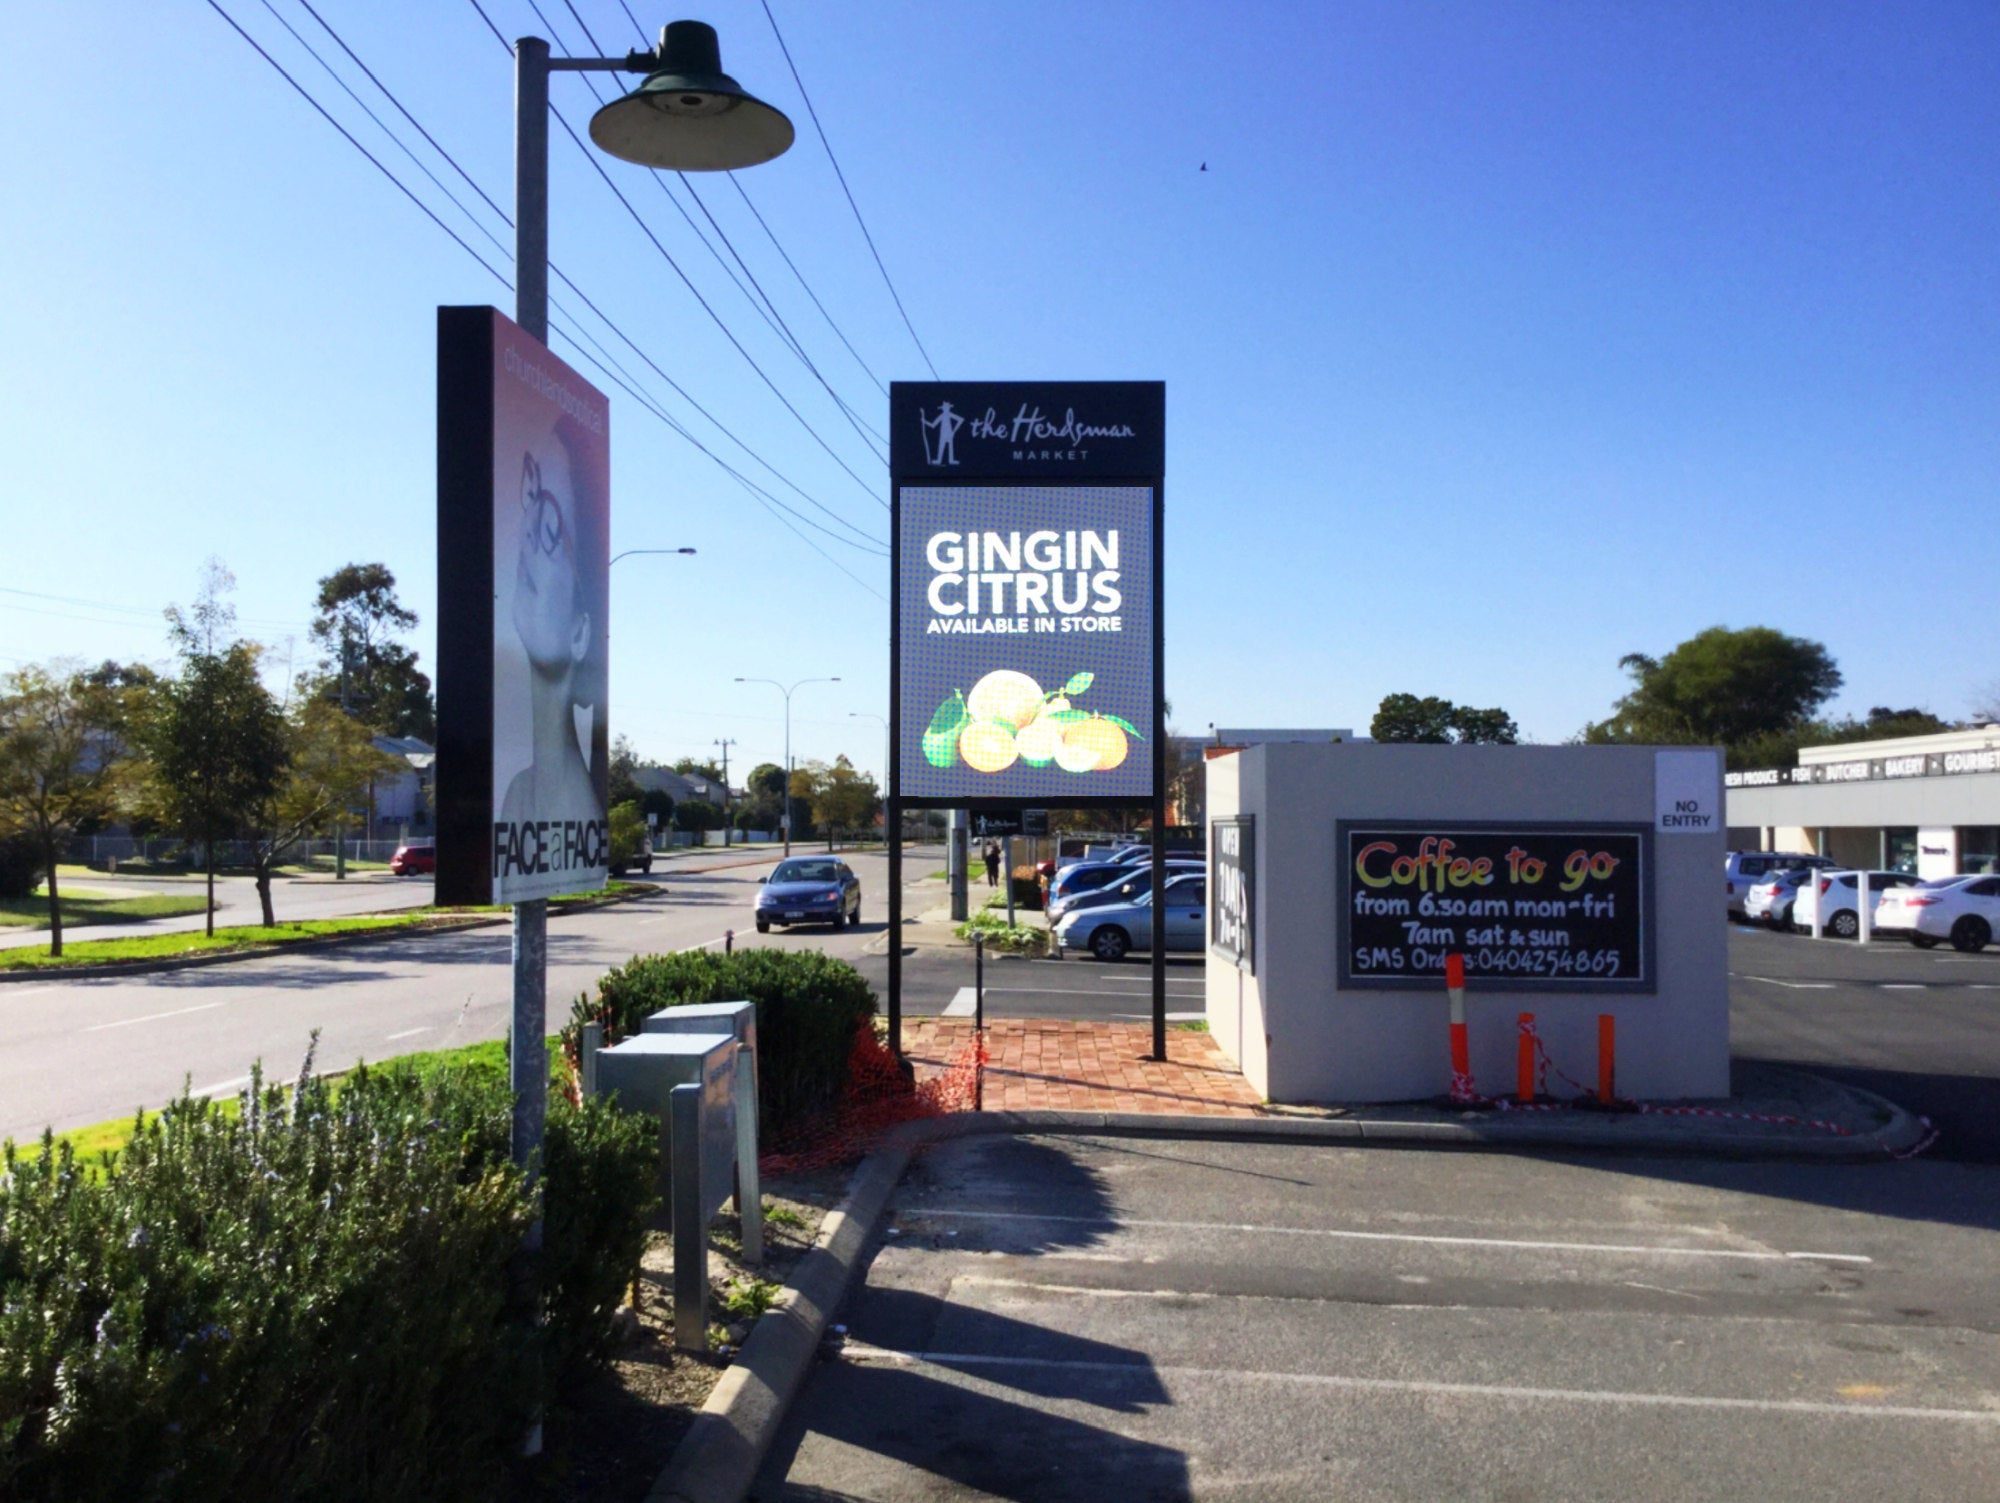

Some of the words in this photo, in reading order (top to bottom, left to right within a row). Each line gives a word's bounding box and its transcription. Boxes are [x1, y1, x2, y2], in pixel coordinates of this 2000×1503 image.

[970, 407, 1008, 439] the
[1010, 403, 1136, 447] Herdsman
[1012, 450, 1088, 461] MARKET
[926, 530, 1119, 572] GINGIN
[927, 570, 1122, 615] CITRUS
[926, 617, 1029, 634] AVAILABLE
[1034, 617, 1055, 632] IN
[1060, 616, 1122, 632] STORE
[1743, 770, 1778, 785] PRODUCE
[1791, 767, 1811, 782] FISH
[1826, 762, 1870, 780] BUTCHER
[1885, 757, 1925, 776] BAKERY
[1675, 800, 1698, 813] NO
[1662, 814, 1711, 827] ENTRY
[494, 821, 549, 878] FACE
[564, 820, 608, 870] FACE
[1356, 836, 1494, 893] Coffee
[1505, 846, 1547, 884] to
[1559, 849, 1620, 892] go
[1354, 890, 1410, 916] from
[1514, 893, 1615, 917] mon-fri
[1401, 921, 1456, 945] 7am
[1466, 924, 1503, 946] sat
[1509, 929, 1525, 945] &
[1528, 929, 1570, 946] sun
[1356, 947, 1404, 969] SMS
